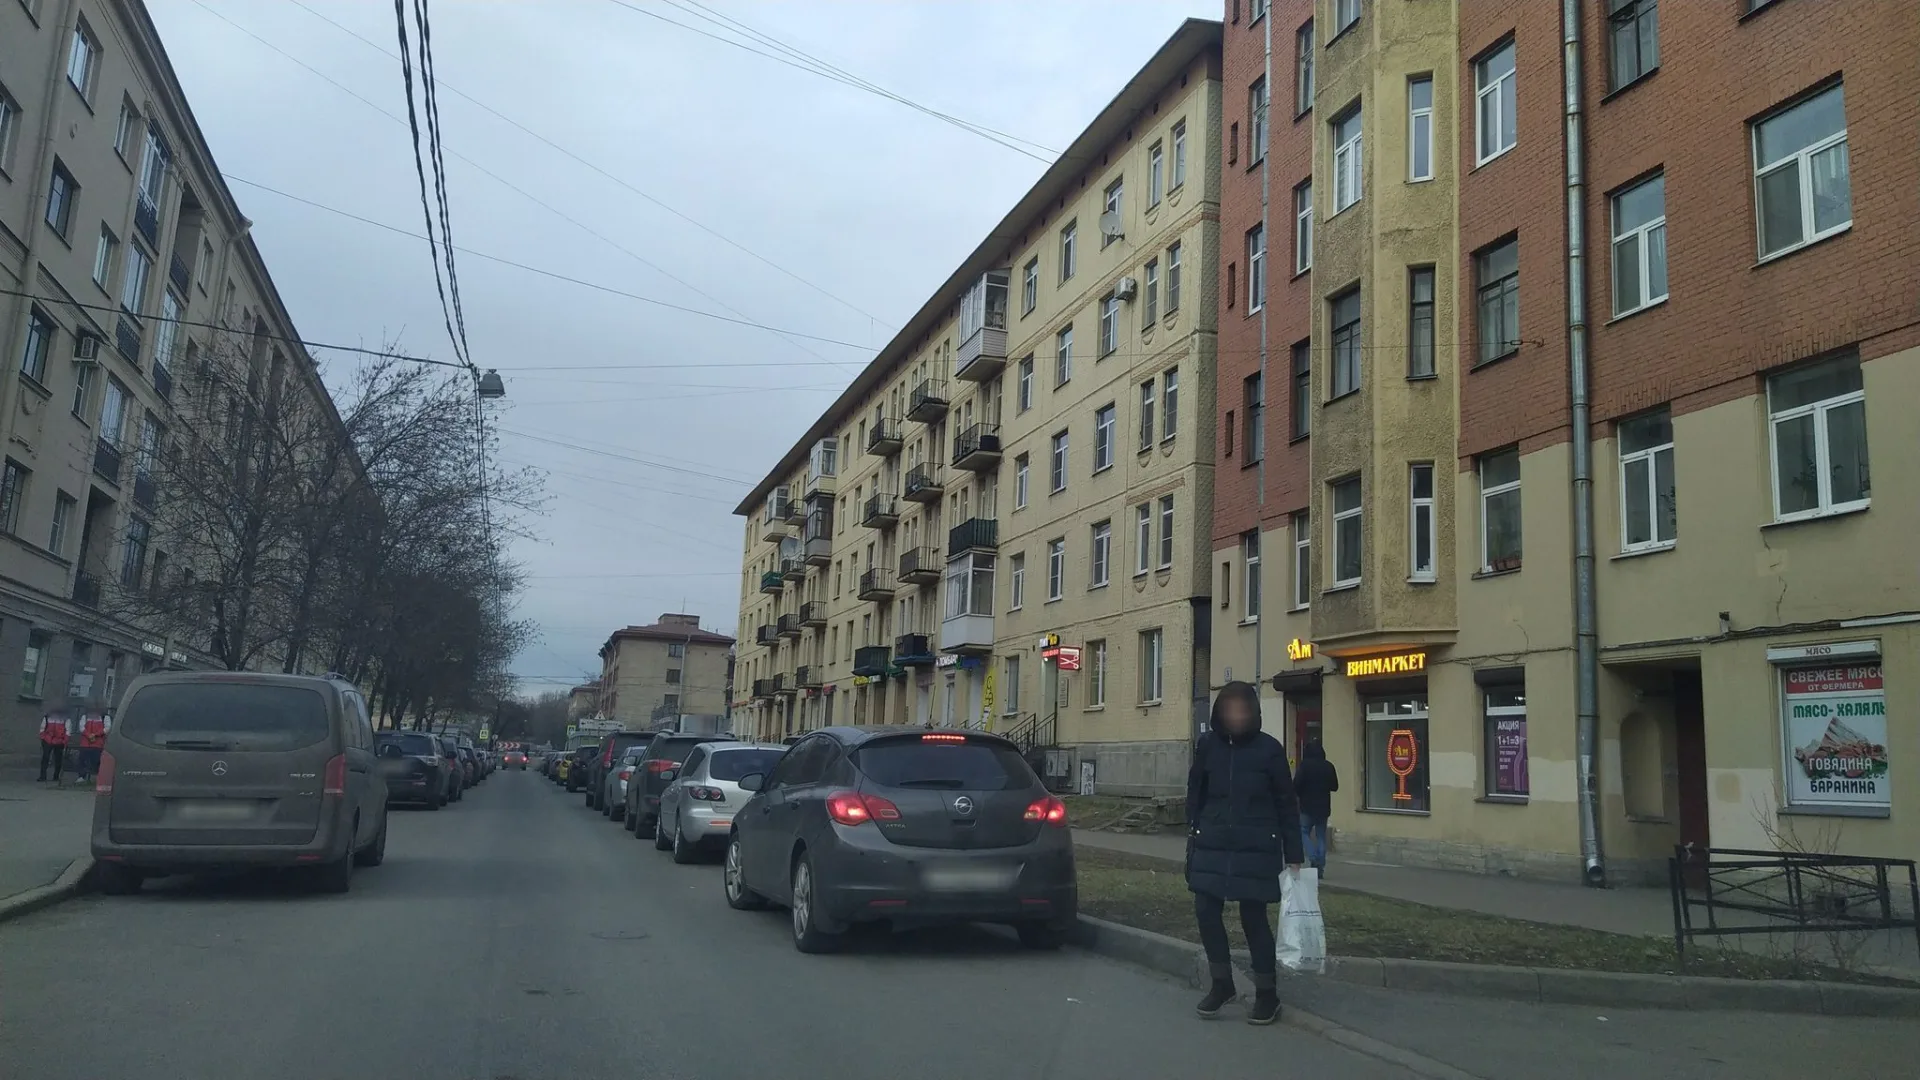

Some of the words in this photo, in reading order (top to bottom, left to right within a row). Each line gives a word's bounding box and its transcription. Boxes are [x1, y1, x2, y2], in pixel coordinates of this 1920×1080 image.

[1287, 638, 1313, 660] Ам
[1805, 646, 1831, 655] МЯСО
[1347, 653, 1426, 676] ВИНМАРКЕТ
[1790, 669, 1843, 683] СВЕЖЕЕ
[1808, 683, 1820, 691] ОТ
[1821, 681, 1864, 691] ФЕРМЕРА
[1837, 701, 1885, 717] ХАЛЯЛЬ
[1497, 720, 1519, 732] АКЦИЯ
[1498, 735, 1520, 746] 1+1=3
[1808, 757, 1873, 772] ГОВЯДИНА
[1810, 780, 1876, 795] БАРАНИНА
